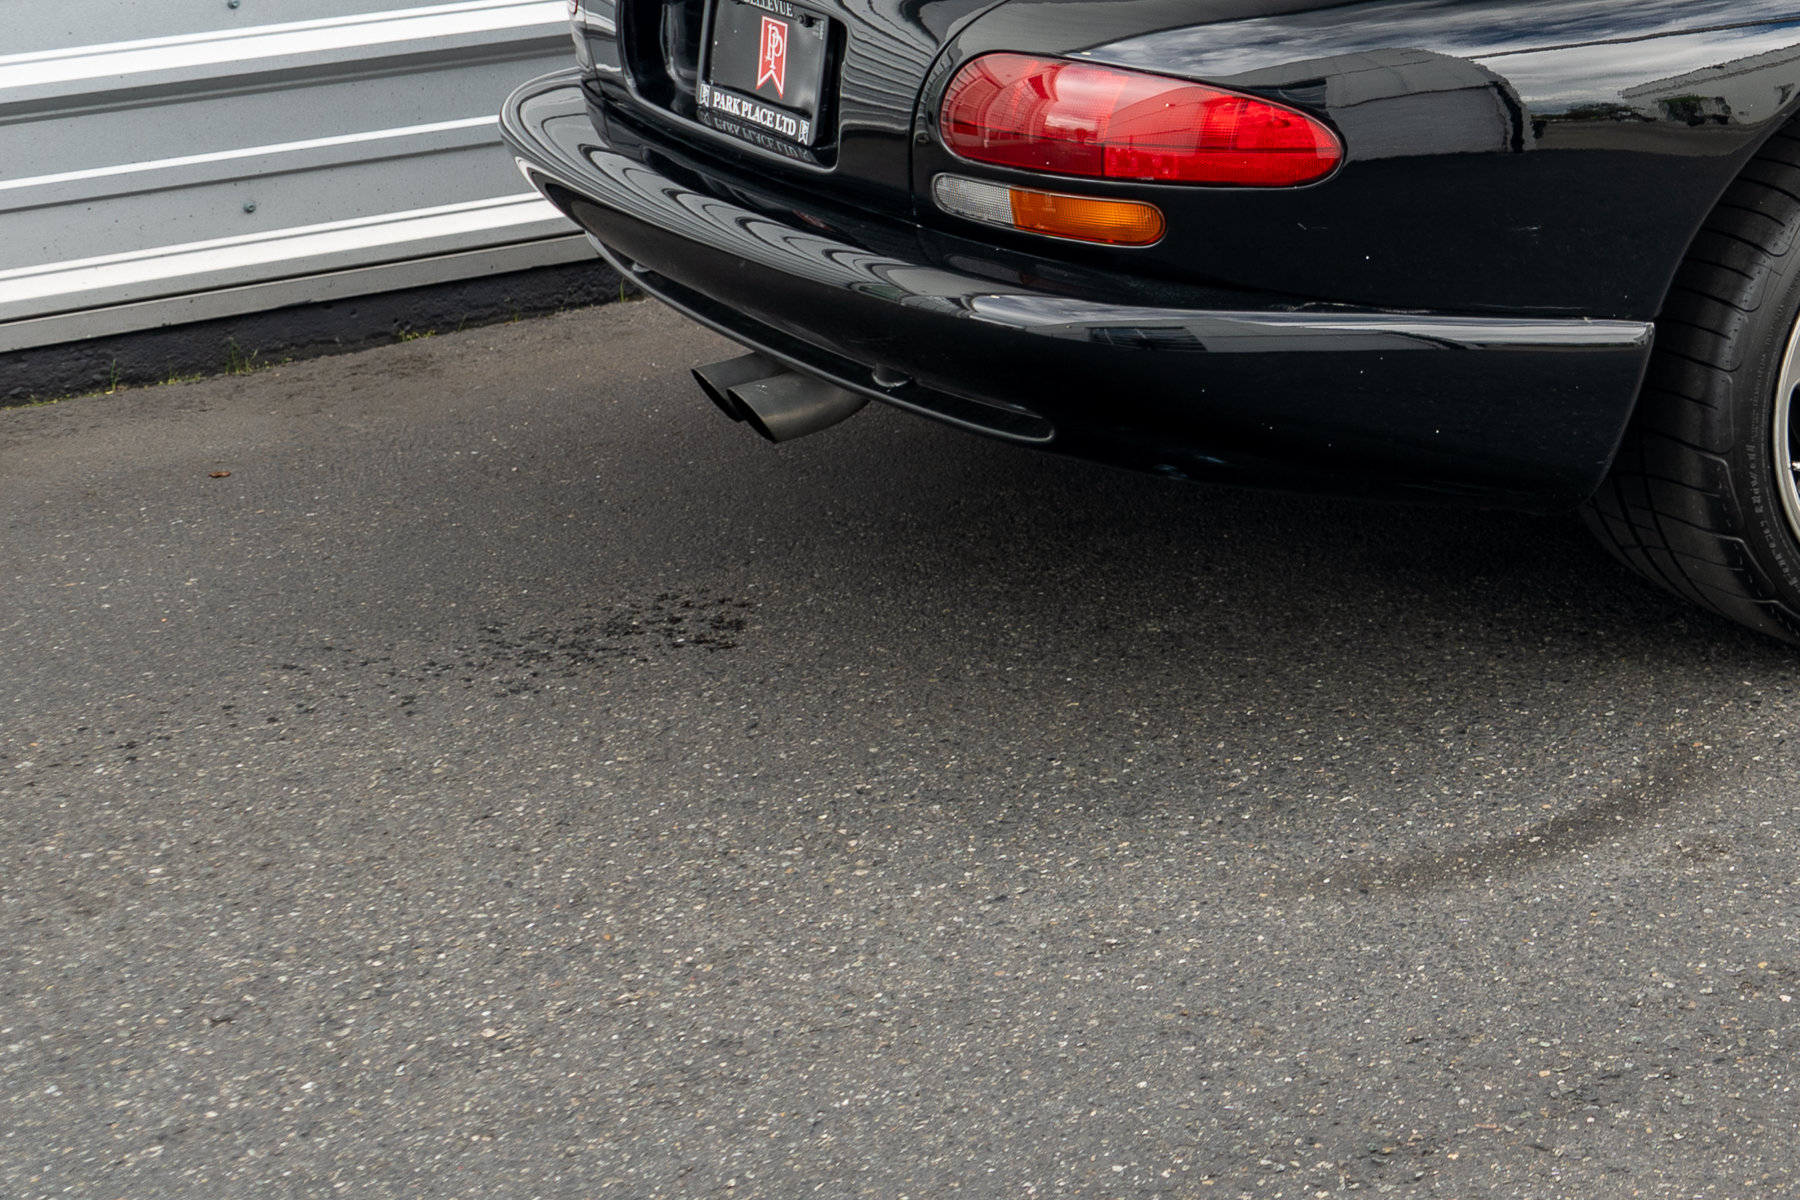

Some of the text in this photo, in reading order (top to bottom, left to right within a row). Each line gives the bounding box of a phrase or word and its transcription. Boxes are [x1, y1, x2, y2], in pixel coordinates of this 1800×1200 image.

[713, 91, 742, 116] PARK
[741, 100, 775, 129] PLACE
[774, 113, 797, 136] LTD
